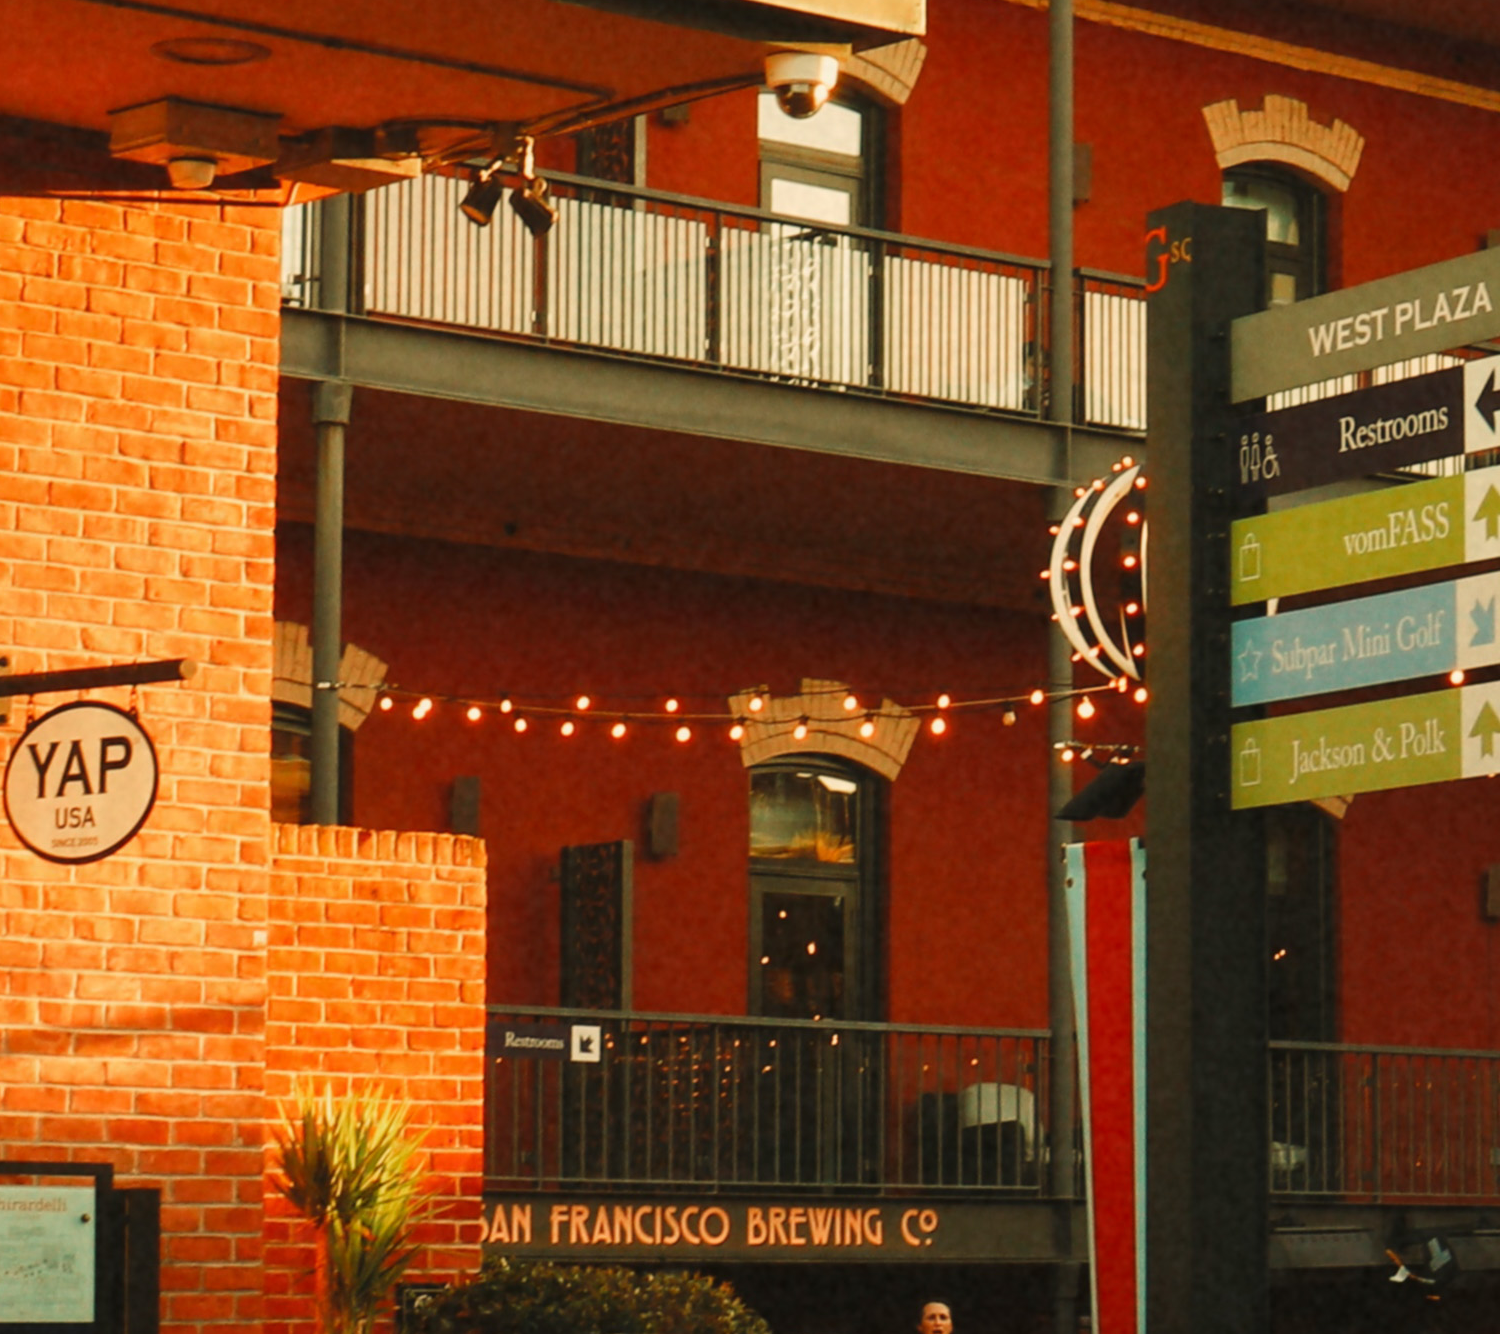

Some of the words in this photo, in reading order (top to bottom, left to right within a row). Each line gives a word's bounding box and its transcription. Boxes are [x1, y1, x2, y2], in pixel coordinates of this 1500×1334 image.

[1308, 307, 1388, 357] WEST
[1394, 281, 1492, 336] PLAZA
[1339, 405, 1448, 454] Restrooms
[1344, 503, 1449, 557] vomFASS
[1271, 633, 1335, 678] Subpar
[1342, 624, 1390, 661] Mini
[1397, 610, 1444, 649] Golf
[27, 736, 133, 799] YAP
[1289, 737, 1365, 783] Jackson
[1372, 732, 1394, 763] &
[1399, 719, 1446, 759] Polk
[55, 806, 96, 829] USA
[505, 1031, 564, 1050] Restrooms
[550, 1205, 730, 1246] FRANCISCO
[747, 1207, 883, 1247] BREWING
